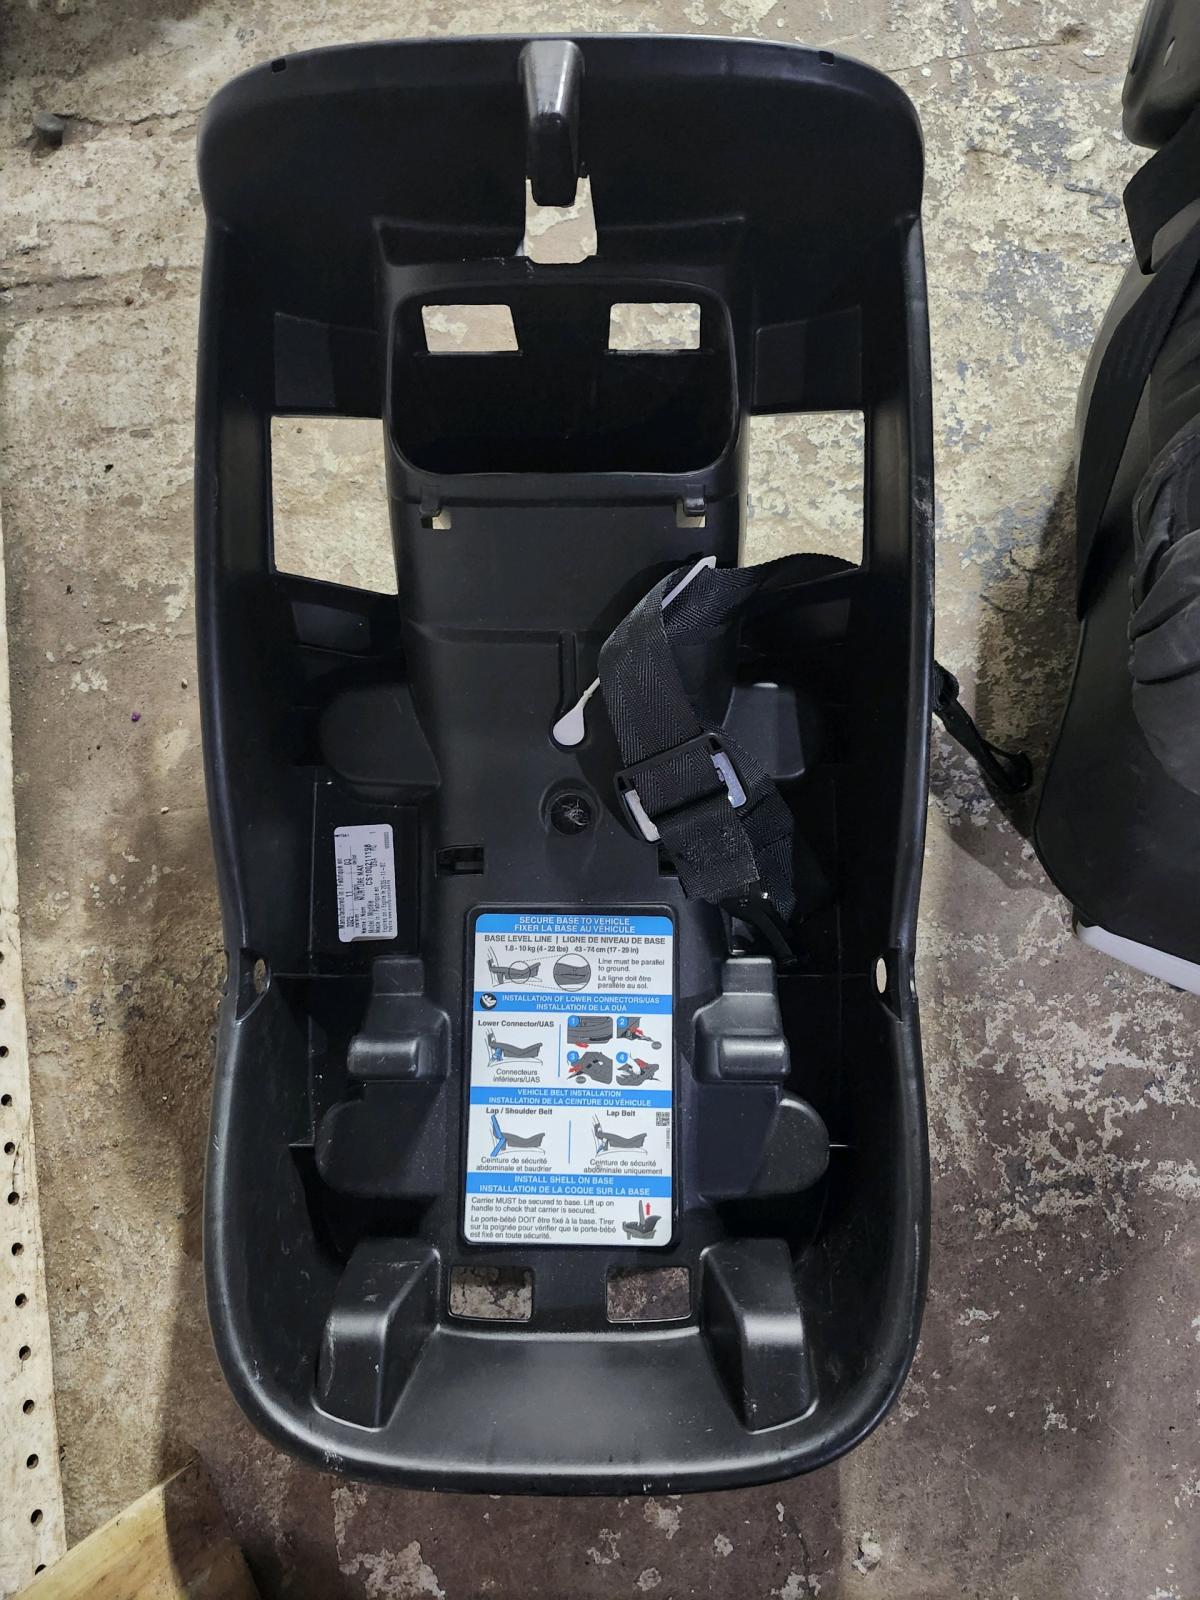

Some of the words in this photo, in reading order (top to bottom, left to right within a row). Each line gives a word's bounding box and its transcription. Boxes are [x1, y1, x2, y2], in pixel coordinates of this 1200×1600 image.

[356, 865, 364, 875] MAX
[582, 917, 592, 925] TO
[594, 918, 630, 926] VEHICLE
[515, 924, 538, 932] FIXER
[630, 947, 639, 955] in)
[640, 959, 665, 967] parallel
[608, 975, 623, 983] ligne
[594, 996, 660, 1004] CONNECTORS/UAS
[536, 1003, 587, 1011] INSTALLATION
[501, 1020, 554, 1028] Connector/UAS
[496, 1068, 538, 1076] Connecteurs
[488, 1096, 539, 1104] INSTALLATION
[565, 1098, 601, 1106] CEINTURE
[486, 1107, 499, 1115] Lap
[481, 1156, 509, 1164] Ceinture
[514, 1175, 548, 1183] INSTALL
[550, 1176, 576, 1184] SHELL
[552, 1186, 563, 1194] LA
[565, 1186, 594, 1194] COQUE
[596, 1187, 614, 1195] SUR
[616, 1187, 626, 1195] LA
[628, 1188, 650, 1196] BASE
[596, 1200, 604, 1208] up
